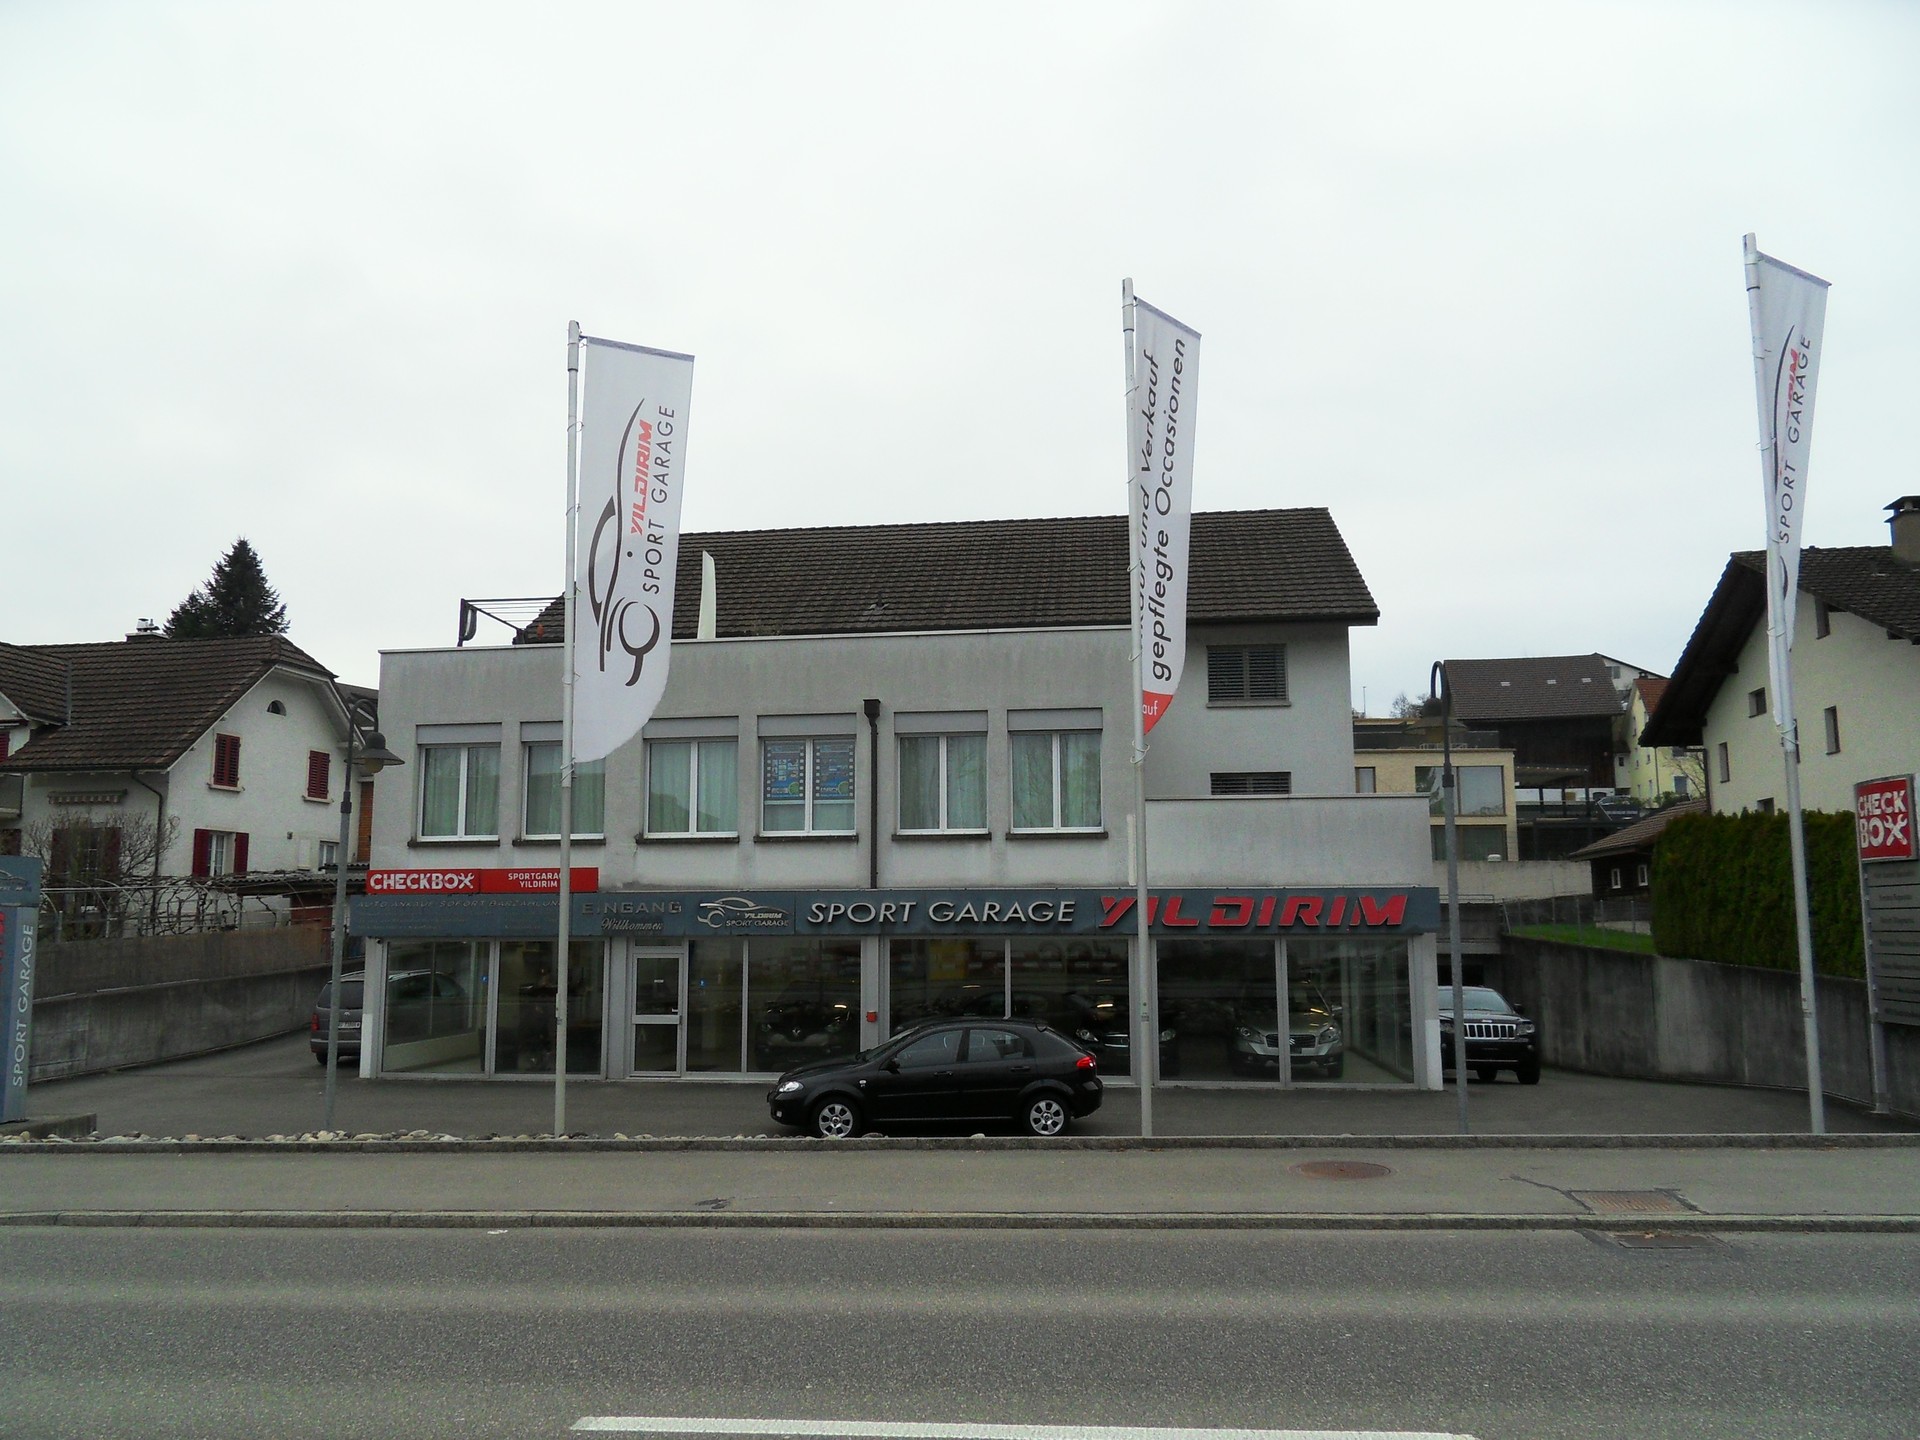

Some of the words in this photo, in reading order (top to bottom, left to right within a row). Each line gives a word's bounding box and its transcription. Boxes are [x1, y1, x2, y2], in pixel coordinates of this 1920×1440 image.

[1141, 349, 1159, 472] Verkauf
[1154, 338, 1186, 516] Occasionen
[651, 405, 675, 504] GARAGE
[1779, 459, 1797, 544] SPORT
[1788, 336, 1812, 444] GARAGE
[630, 418, 653, 537] YILDIRIM
[642, 518, 665, 595] SPORT
[1148, 529, 1174, 682] gepflegte
[1858, 790, 1907, 817] CHECK
[1859, 813, 1908, 849] BOX
[369, 872, 475, 890] CHECKBOX
[507, 872, 561, 881] SPORTGARA
[519, 880, 558, 888] YILDIRIM
[582, 901, 682, 915] EINGANG
[601, 917, 664, 931] Willkommen
[807, 902, 917, 924] SPORT
[928, 901, 1076, 924] GARAGE
[1098, 894, 1408, 927] YILDIRIM
[18, 924, 34, 1013] GARAGE
[13, 1019, 27, 1088] SPORT
